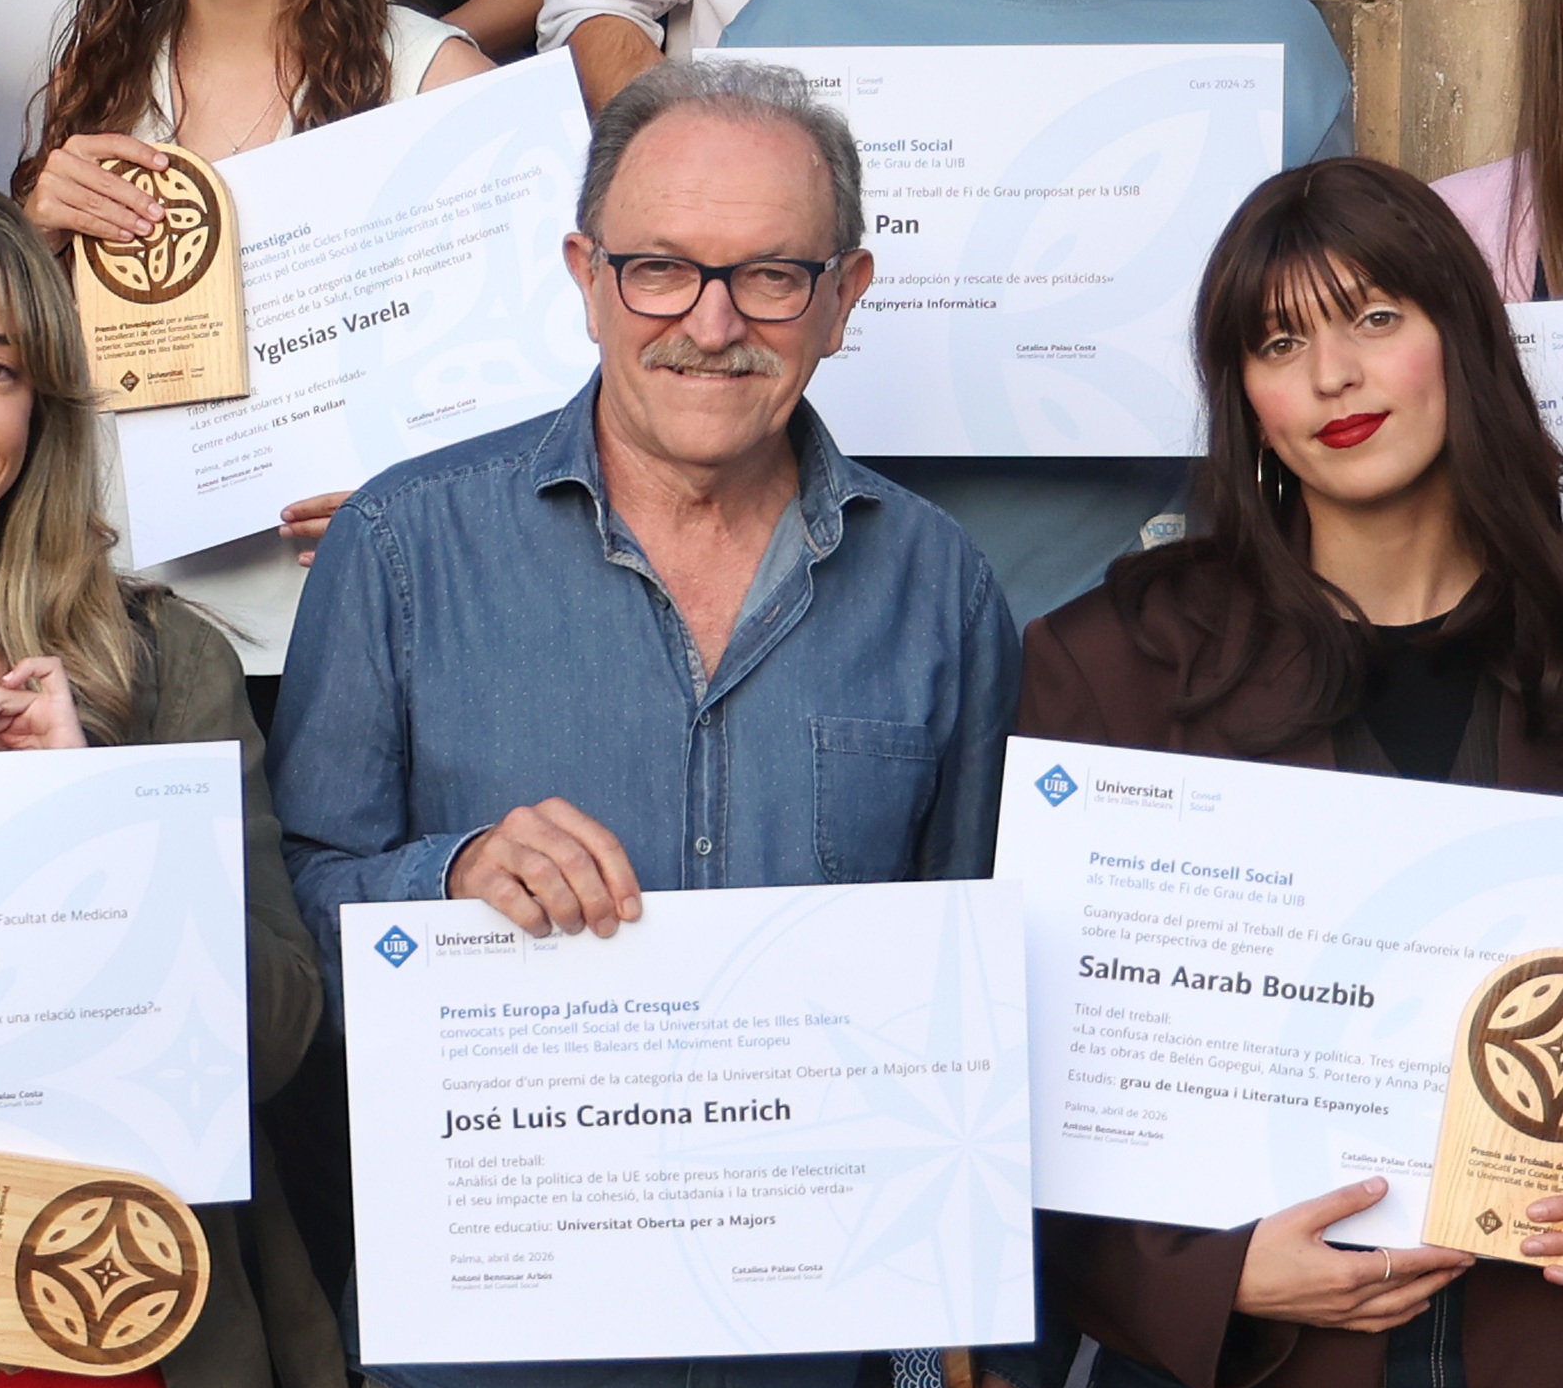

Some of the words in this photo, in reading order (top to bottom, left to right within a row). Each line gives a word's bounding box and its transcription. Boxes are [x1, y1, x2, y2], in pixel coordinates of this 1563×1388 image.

[854, 139, 906, 153] Consell
[910, 139, 953, 152] Social
[876, 214, 919, 235] Pan
[927, 298, 997, 309] Informàtica
[254, 325, 339, 364] Yglesias
[342, 300, 410, 333] Varela
[1044, 778, 1068, 794] UIB
[1095, 779, 1173, 800] Universitat
[1089, 851, 1145, 871] Premis
[1150, 858, 1176, 874] del
[1180, 861, 1240, 881] Consell
[1245, 868, 1294, 887] Social
[383, 939, 408, 955] UIB
[435, 931, 515, 947] Universitat
[1078, 955, 1161, 985] Salma
[1170, 965, 1252, 995] Aarab
[1262, 975, 1375, 1009] Bouzbib
[440, 1004, 497, 1020] Premis
[502, 1003, 560, 1020] Europa
[563, 999, 619, 1020] Jafudà
[623, 999, 700, 1016] Cresques
[1068, 1068, 1117, 1085] Estudis:
[1119, 1077, 1151, 1091] grau
[1154, 1078, 1172, 1092] de
[1176, 1081, 1229, 1100] Llengua
[1233, 1087, 1238, 1099] i
[1242, 1088, 1309, 1107] Literatura
[1313, 1096, 1389, 1116] Espanyoles
[440, 1106, 501, 1139] José
[512, 1105, 567, 1129] Luis
[576, 1102, 692, 1128] Cardona
[704, 1097, 791, 1123] Enrich
[449, 1222, 490, 1235] Centre
[494, 1222, 553, 1233] educatiu:
[556, 1218, 633, 1232] Universitat
[636, 1217, 686, 1230] Oberta
[689, 1218, 713, 1231] per
[716, 1217, 725, 1227] a
[729, 1214, 776, 1230] Majors
